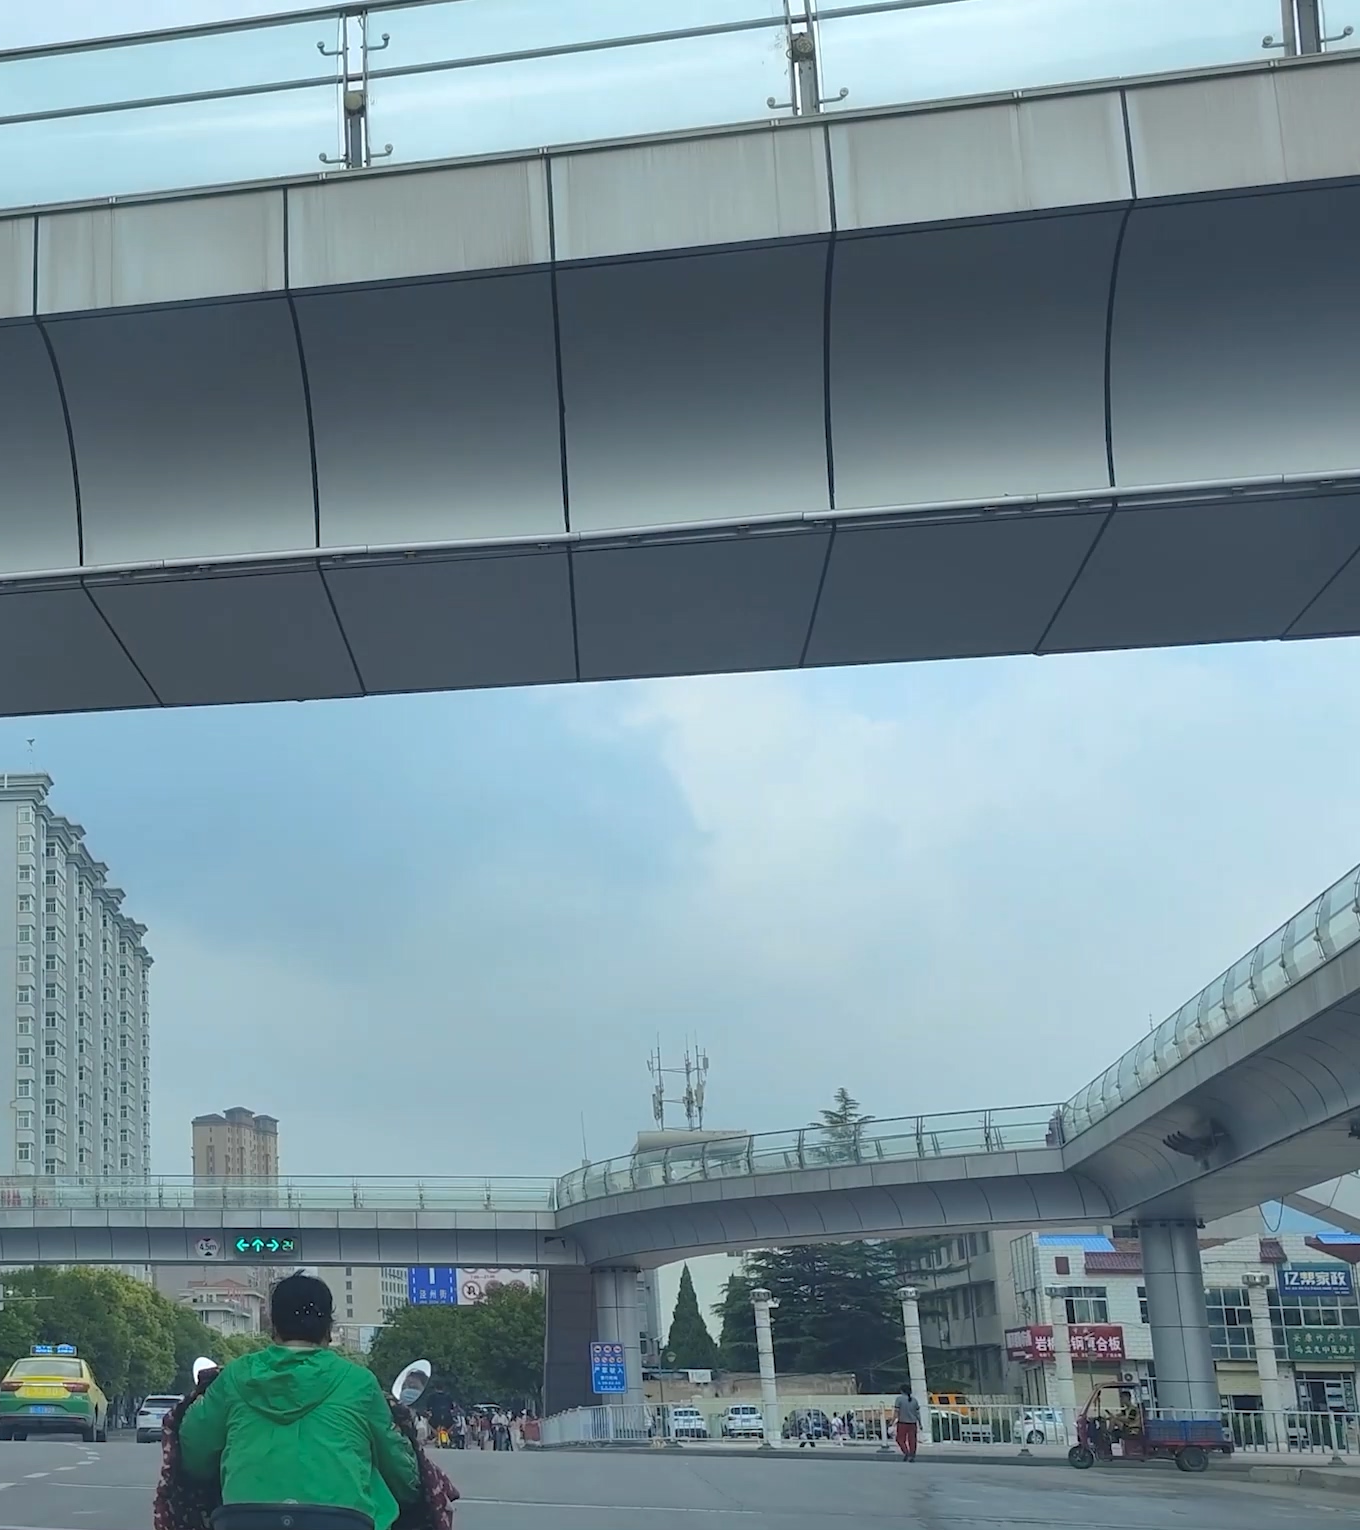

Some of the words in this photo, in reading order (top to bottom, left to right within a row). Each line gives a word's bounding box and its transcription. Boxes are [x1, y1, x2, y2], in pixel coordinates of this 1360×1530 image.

[200, 1243, 217, 1251] 4.5m
[282, 1241, 294, 1251] 24
[1284, 1272, 1347, 1286] 亿帮家政
